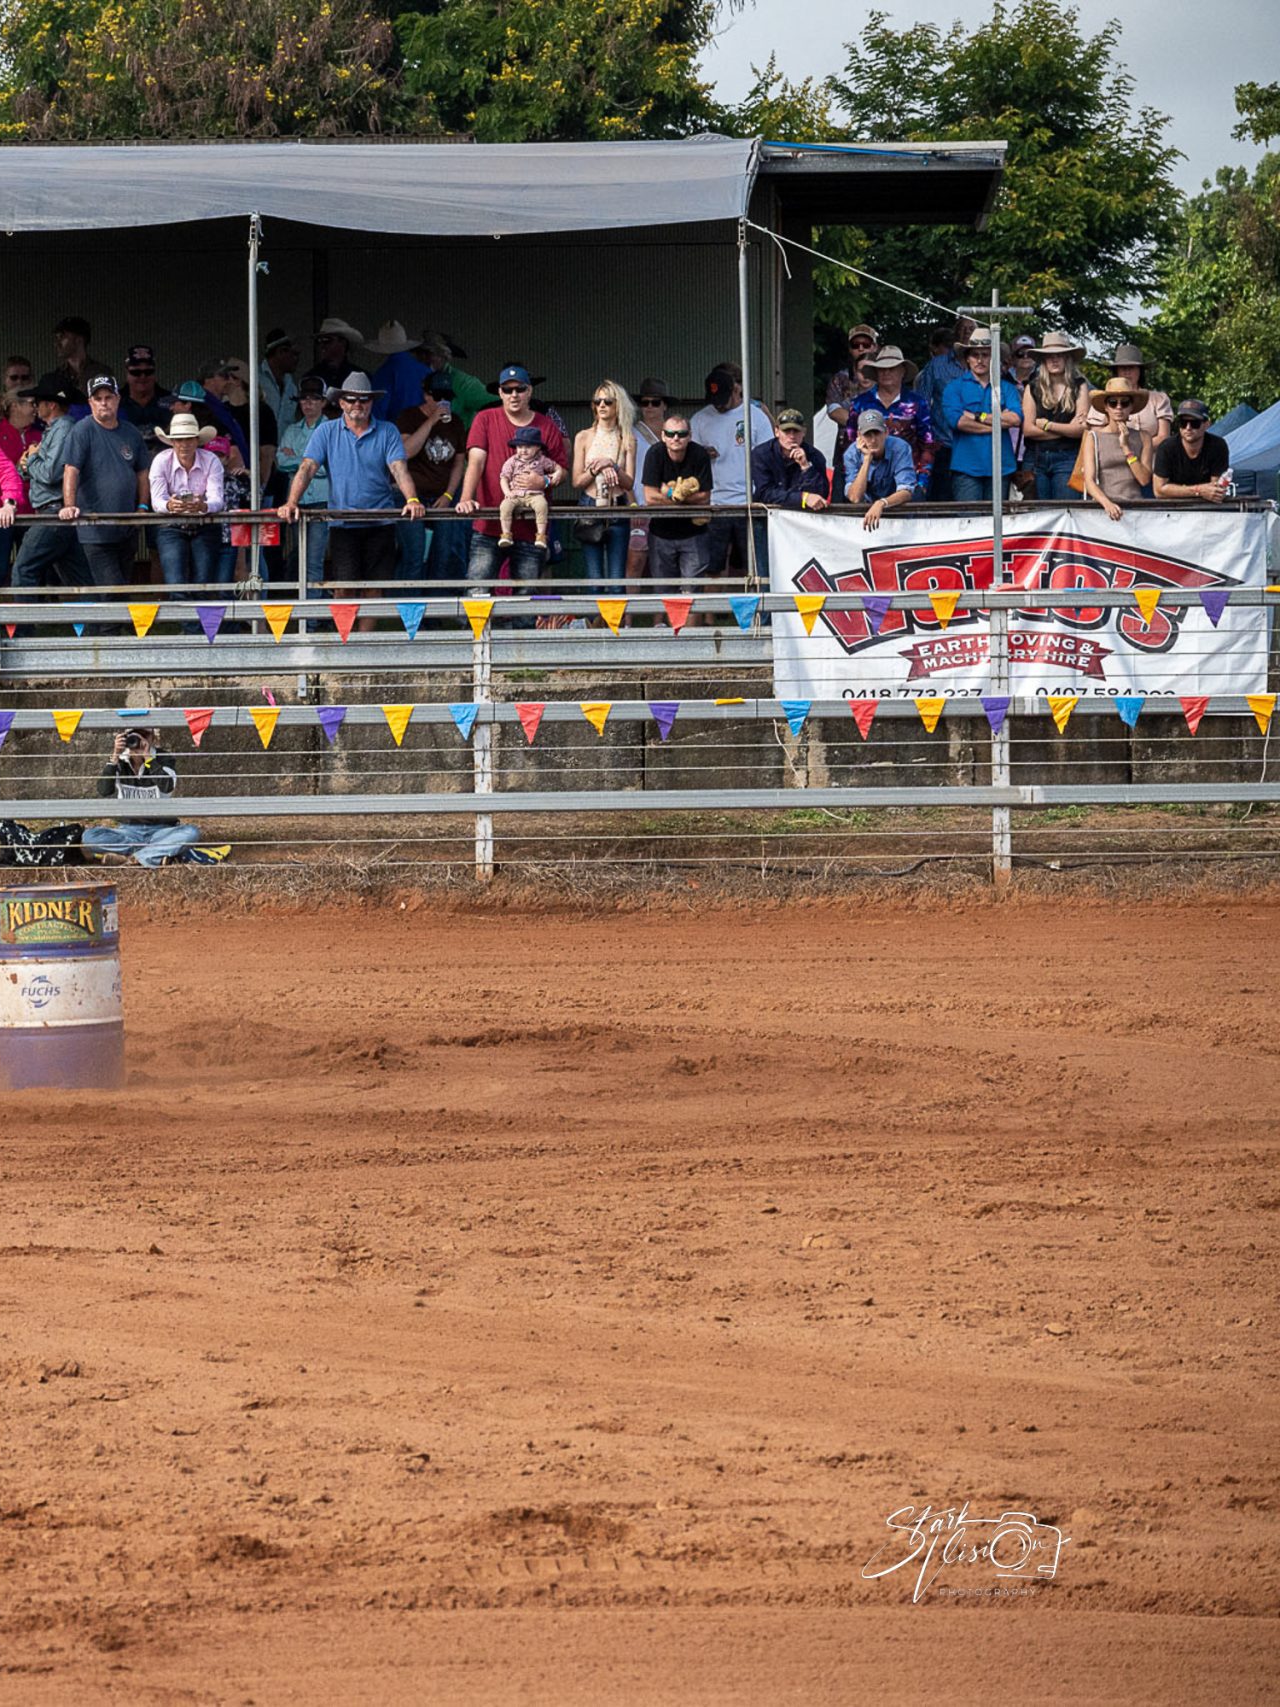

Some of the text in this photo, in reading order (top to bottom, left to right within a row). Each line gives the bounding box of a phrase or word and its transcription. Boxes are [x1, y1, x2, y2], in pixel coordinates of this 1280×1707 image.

[918, 633, 1095, 657] EARTHOVING &
[922, 649, 1091, 669] MACHIRY HIRE
[7, 900, 96, 935] KIDNER
[21, 986, 61, 996] FUCHS
